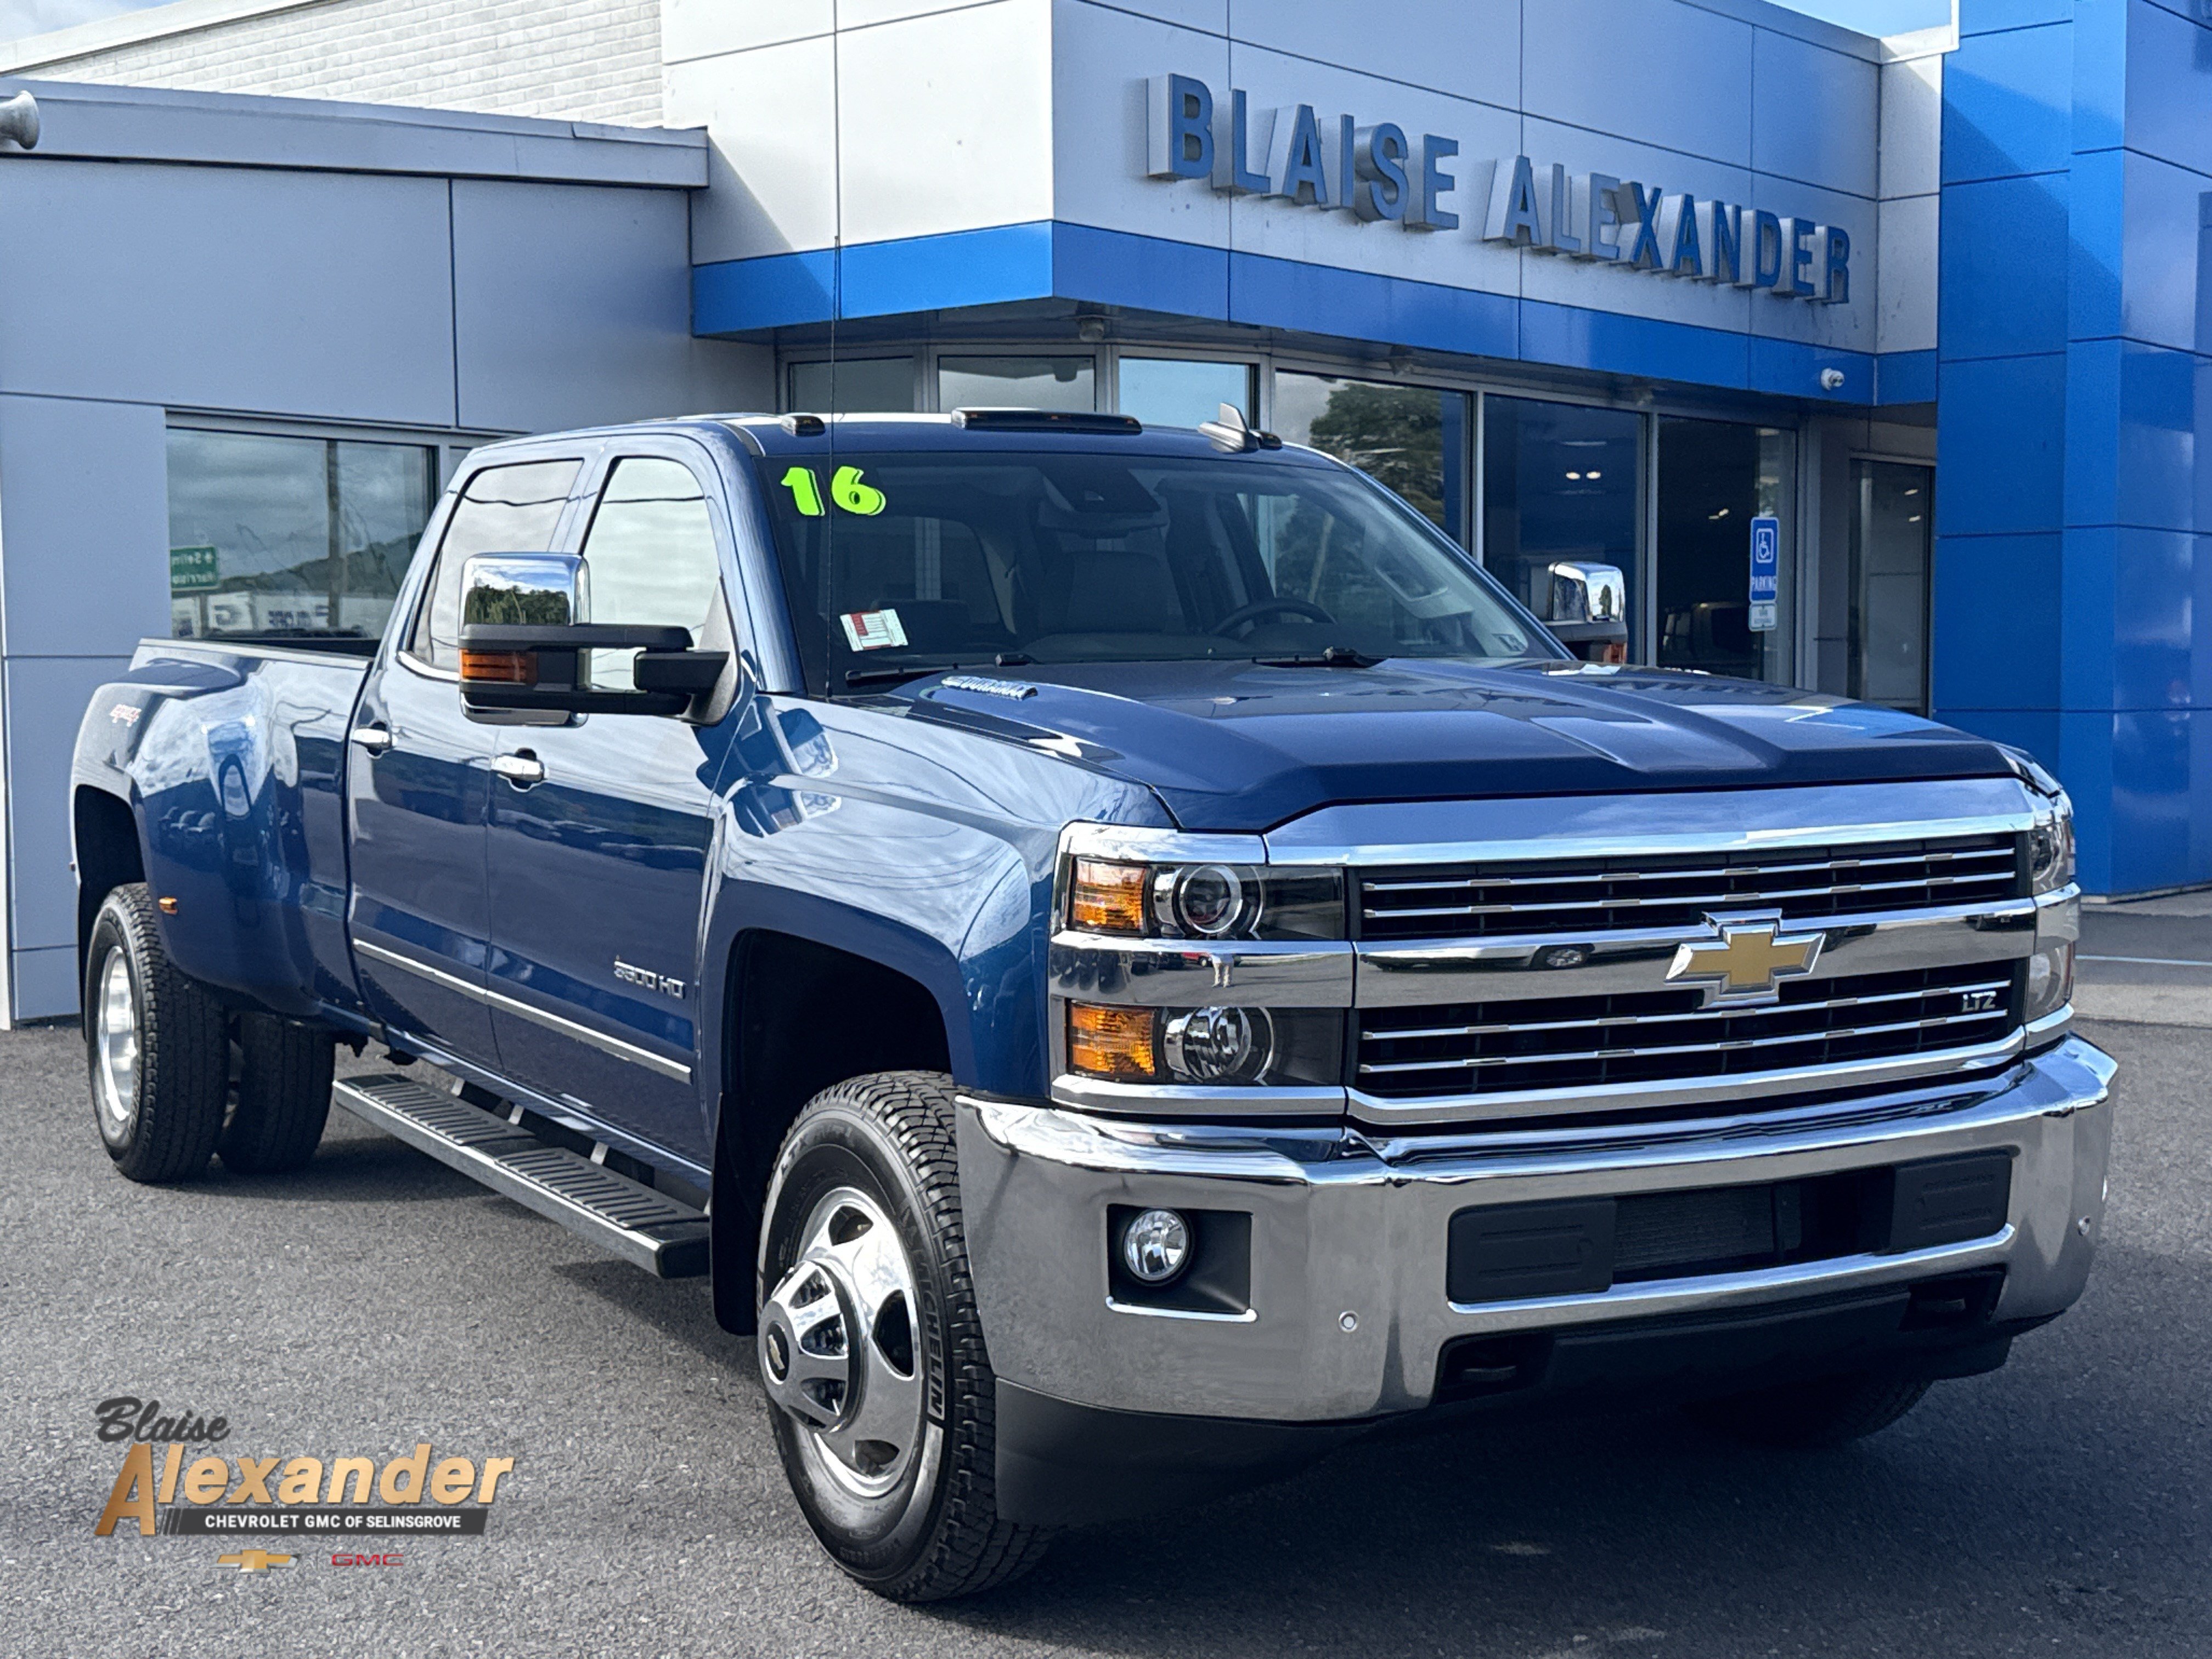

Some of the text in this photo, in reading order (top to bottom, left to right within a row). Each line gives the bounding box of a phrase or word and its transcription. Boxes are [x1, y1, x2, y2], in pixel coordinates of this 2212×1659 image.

[1164, 72, 1850, 304] BLAISE ALEXANDER
[781, 466, 887, 516] 16
[1961, 990, 1997, 1013] LTZ
[910, 1248, 945, 1419] MICHELIN
